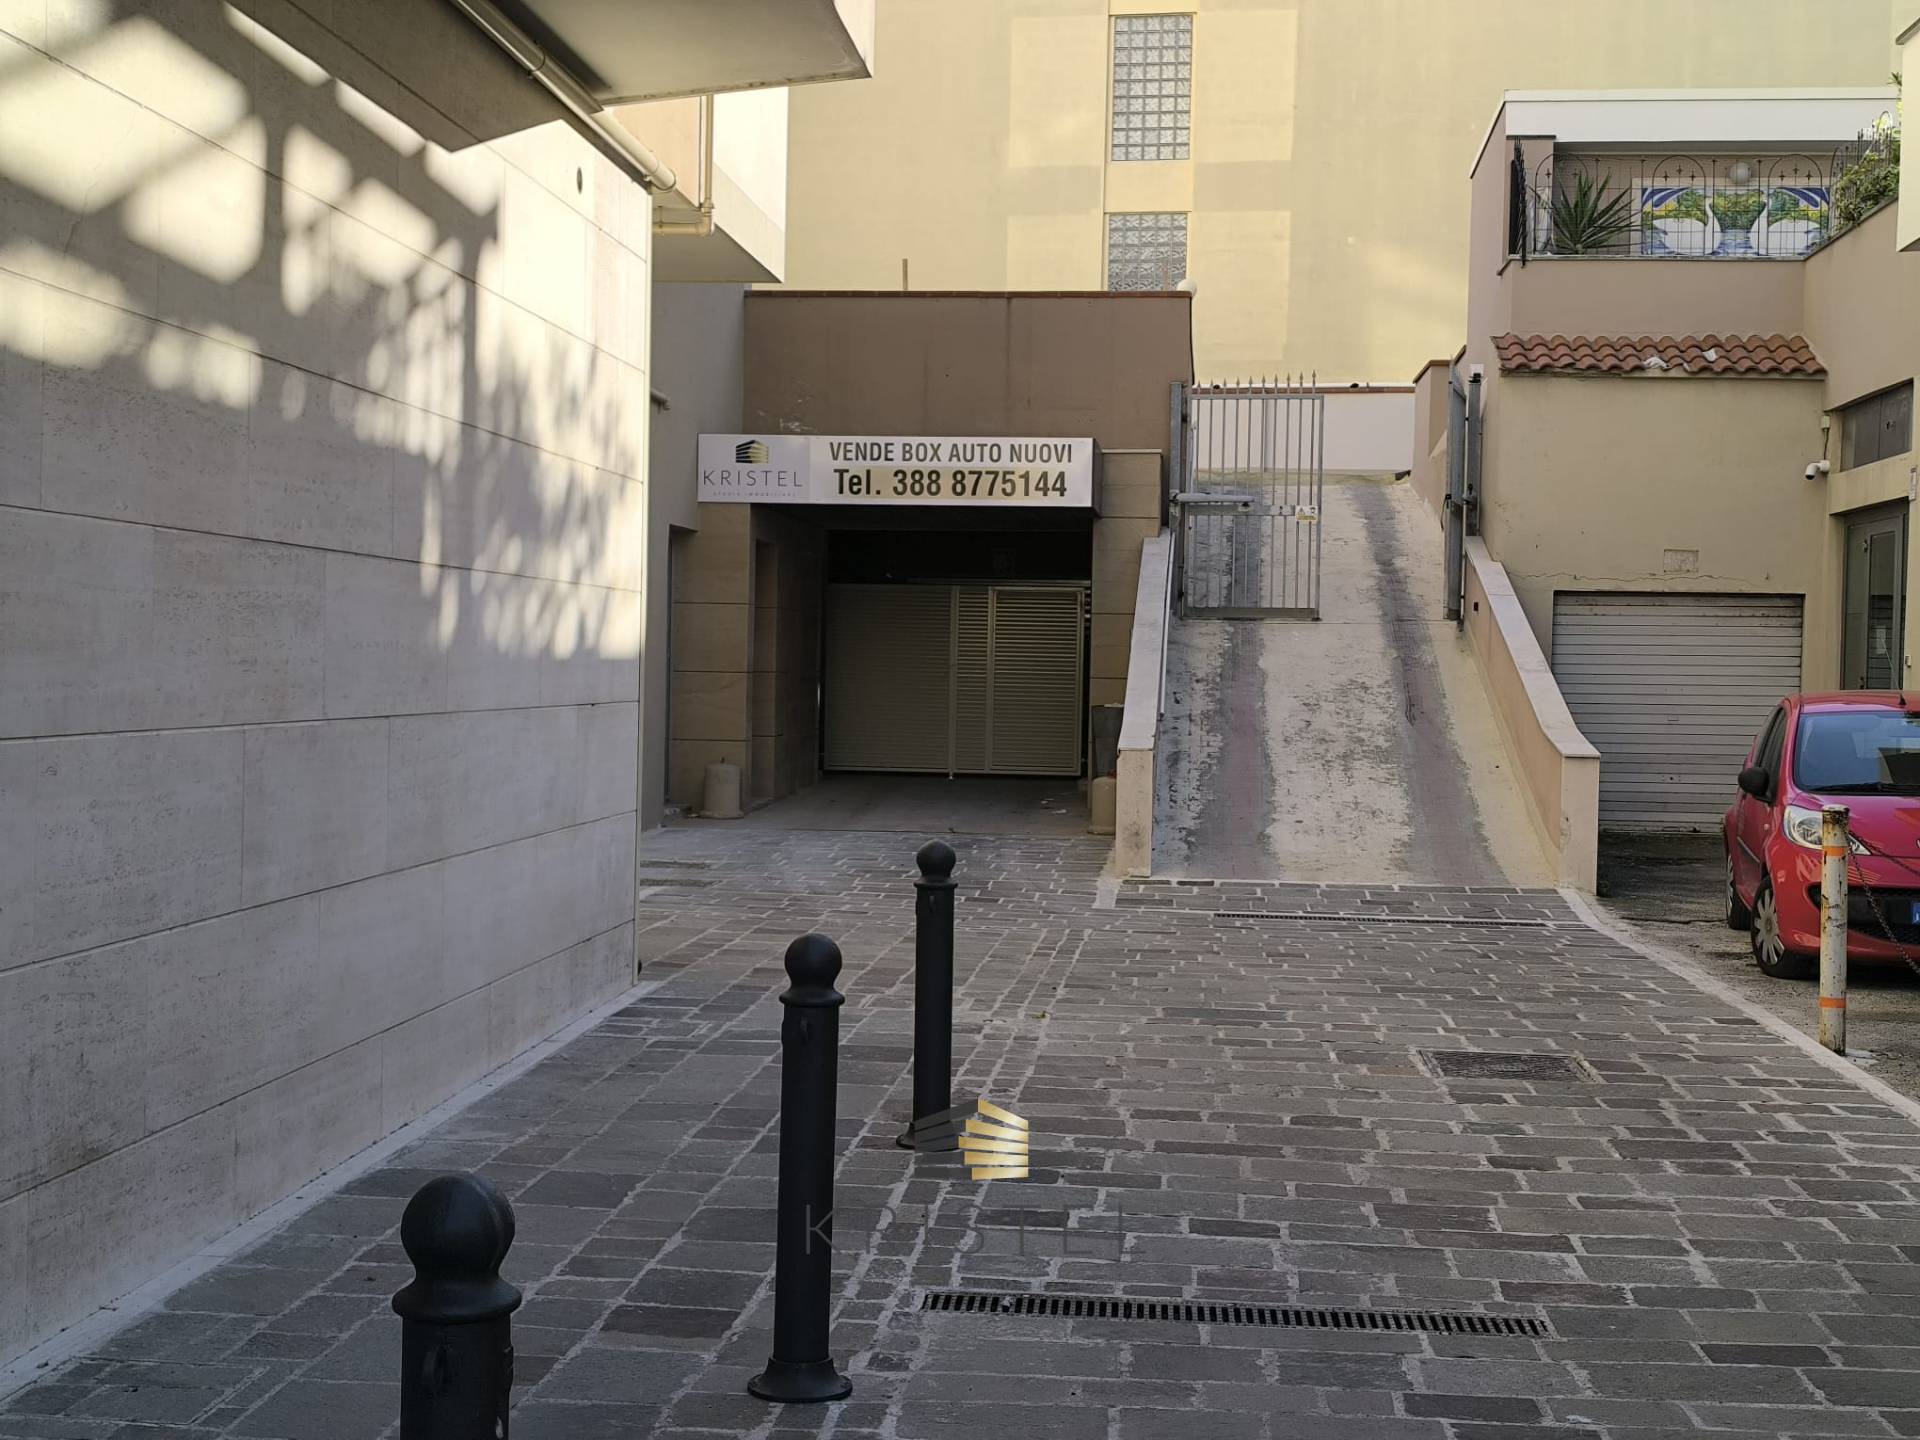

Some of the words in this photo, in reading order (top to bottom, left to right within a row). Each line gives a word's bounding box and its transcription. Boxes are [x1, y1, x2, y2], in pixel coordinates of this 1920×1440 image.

[829, 442, 894, 461] VENDE
[902, 443, 942, 462] BOX
[948, 442, 1001, 462] AUTO
[1009, 444, 1072, 463] NUOVI
[703, 470, 803, 487] KRISTEL
[833, 469, 881, 495] Tel.
[893, 469, 941, 496] 388
[952, 470, 1067, 497] 8775144
